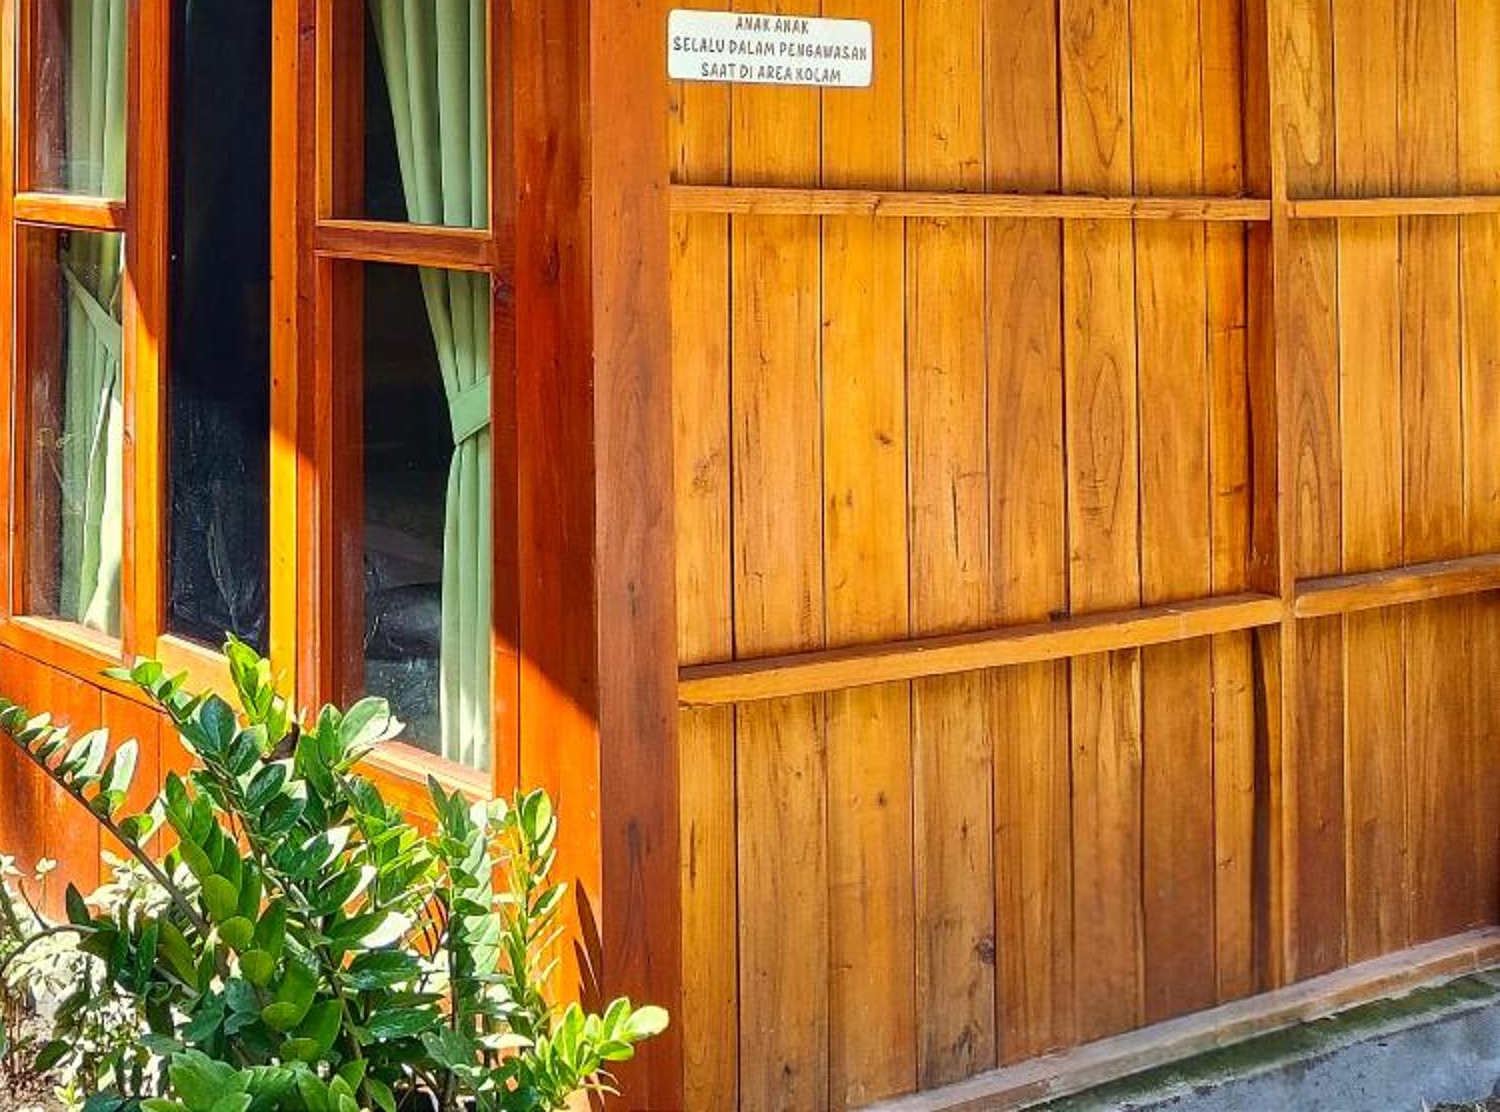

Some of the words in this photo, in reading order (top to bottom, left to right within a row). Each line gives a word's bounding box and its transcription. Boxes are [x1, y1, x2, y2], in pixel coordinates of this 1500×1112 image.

[735, 16, 771, 33] ANAK
[774, 18, 809, 34] ANAK
[673, 36, 725, 53] SELALU
[729, 39, 775, 56] DALAM
[779, 42, 867, 60] PENGAWASAN
[701, 62, 736, 78] SAAT
[740, 64, 753, 79] DI
[757, 65, 793, 81] AREA
[796, 67, 841, 83] KOLAM
